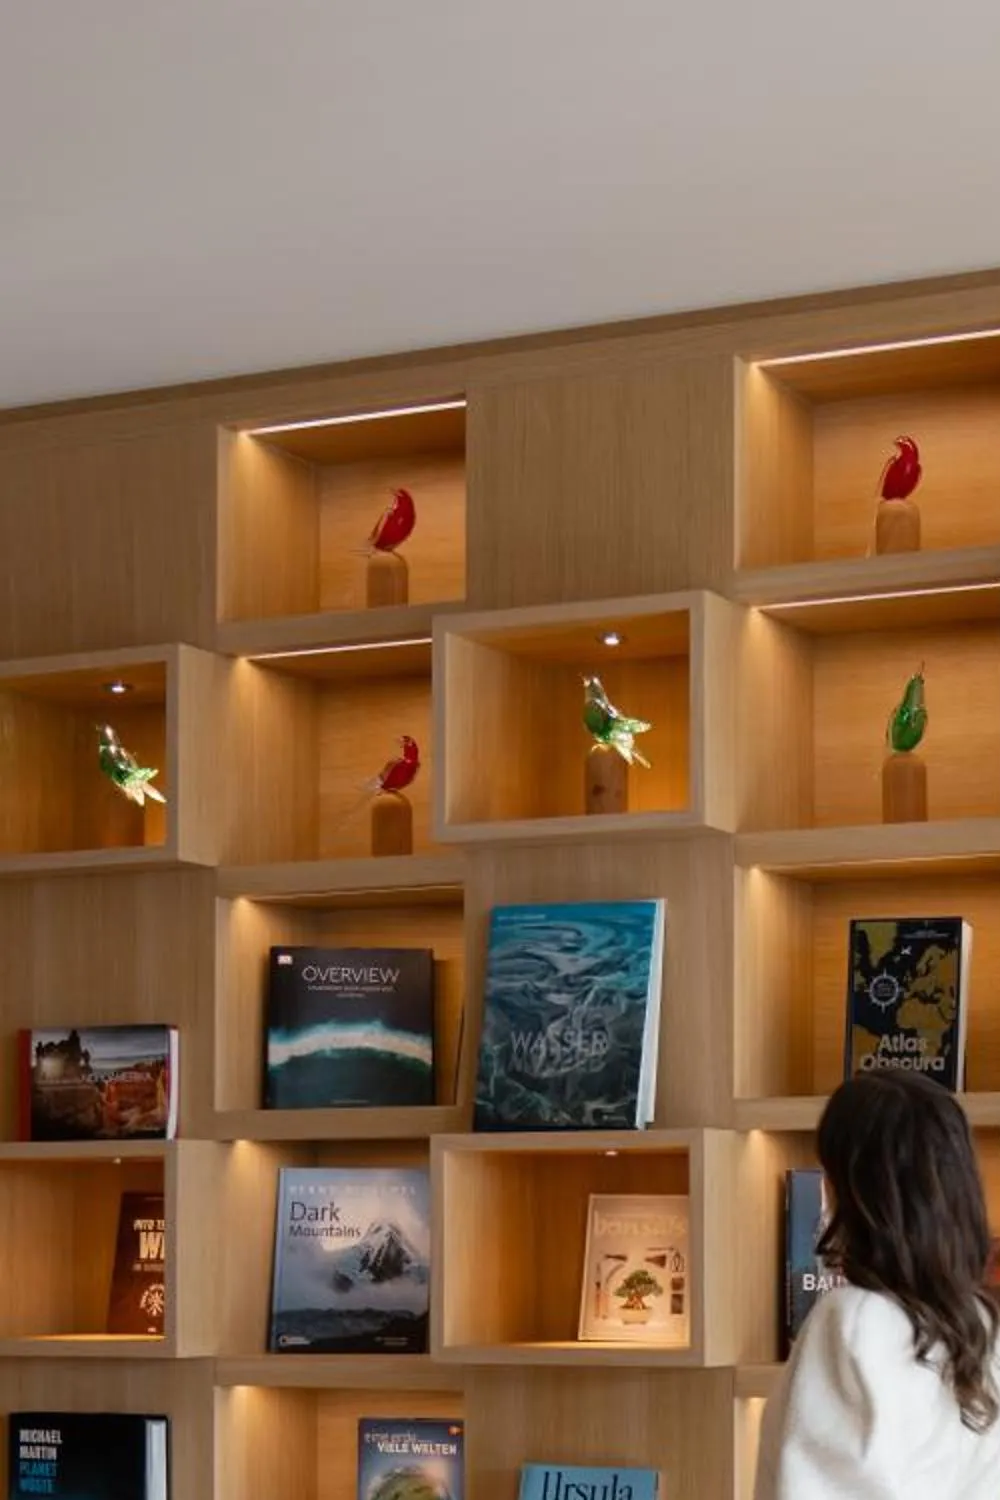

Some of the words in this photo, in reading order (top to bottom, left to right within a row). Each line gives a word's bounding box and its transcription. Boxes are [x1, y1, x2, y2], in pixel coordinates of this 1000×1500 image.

[301, 965, 400, 984] OVERVIEW
[510, 1030, 608, 1056] WASSER
[878, 1033, 927, 1052] Atlas
[860, 1054, 946, 1071] Obscura
[290, 1201, 341, 1222] Dark
[289, 1225, 361, 1238] Mountains
[20, 1429, 63, 1444] MICHAEL
